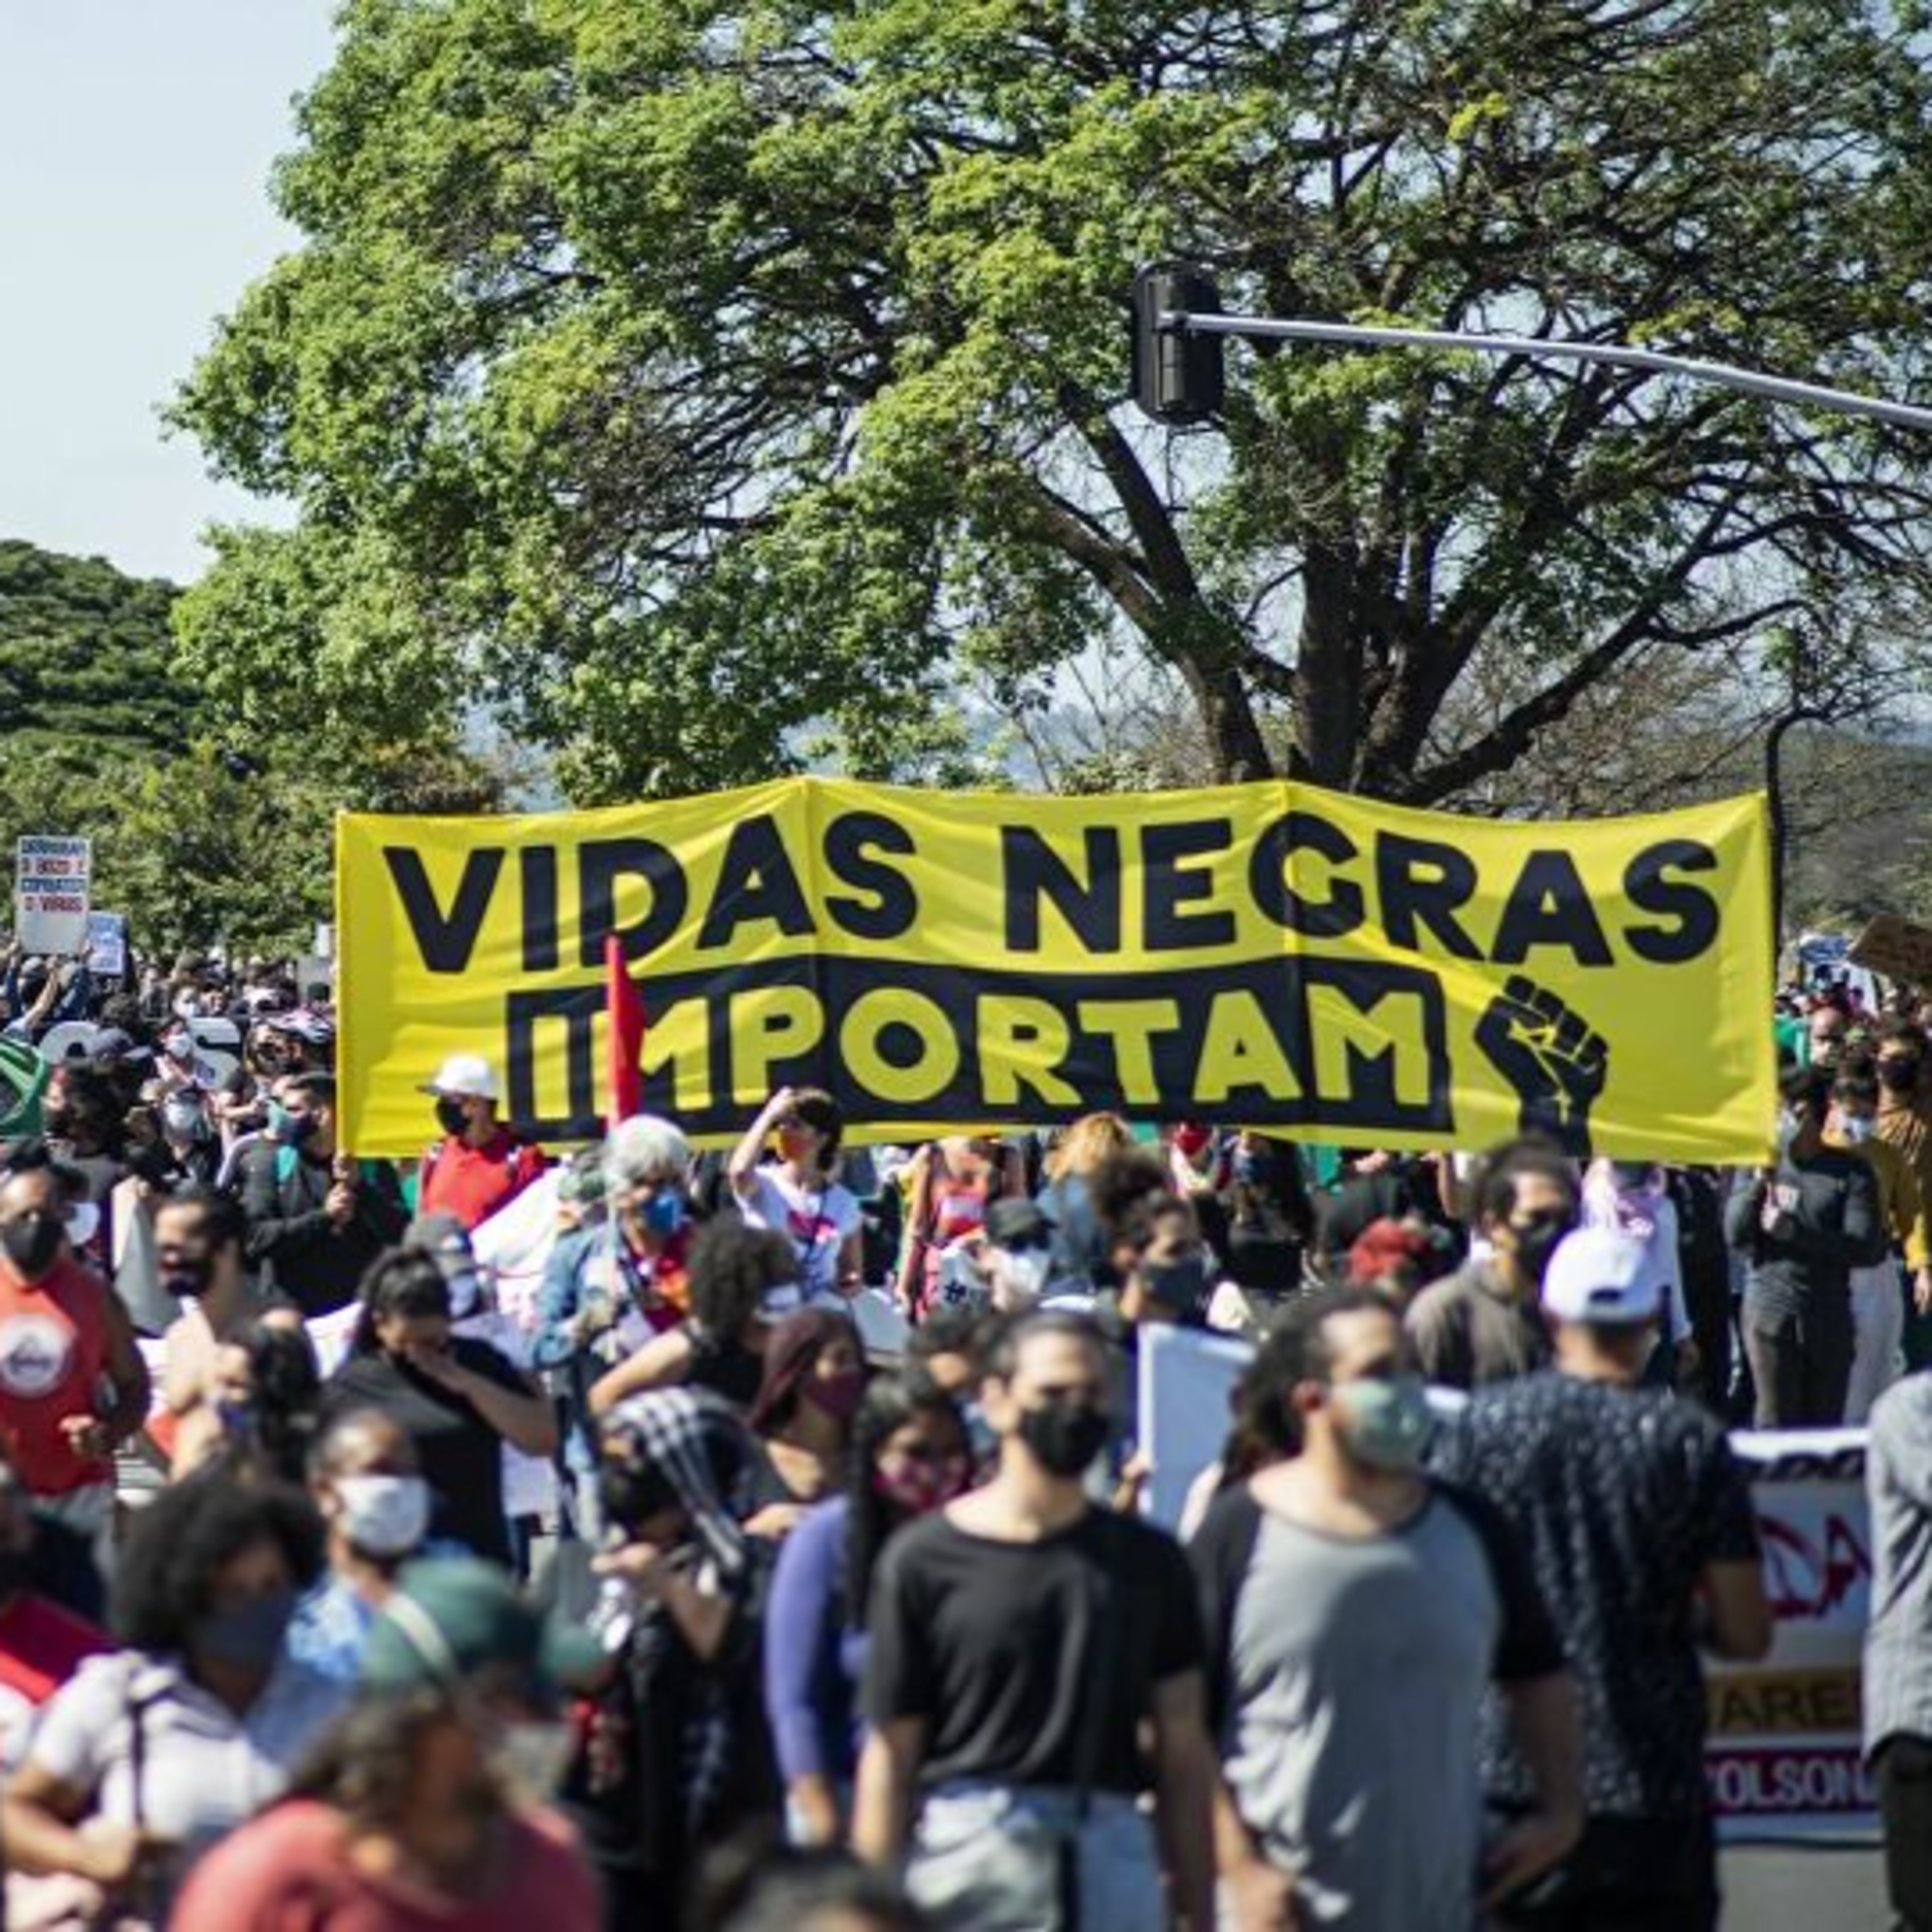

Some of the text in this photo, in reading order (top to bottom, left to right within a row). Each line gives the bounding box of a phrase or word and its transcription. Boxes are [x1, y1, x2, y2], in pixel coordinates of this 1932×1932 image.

[383, 810, 1720, 972] VIDAS NEGRAS
[532, 982, 1430, 1119] IMPORTAM
